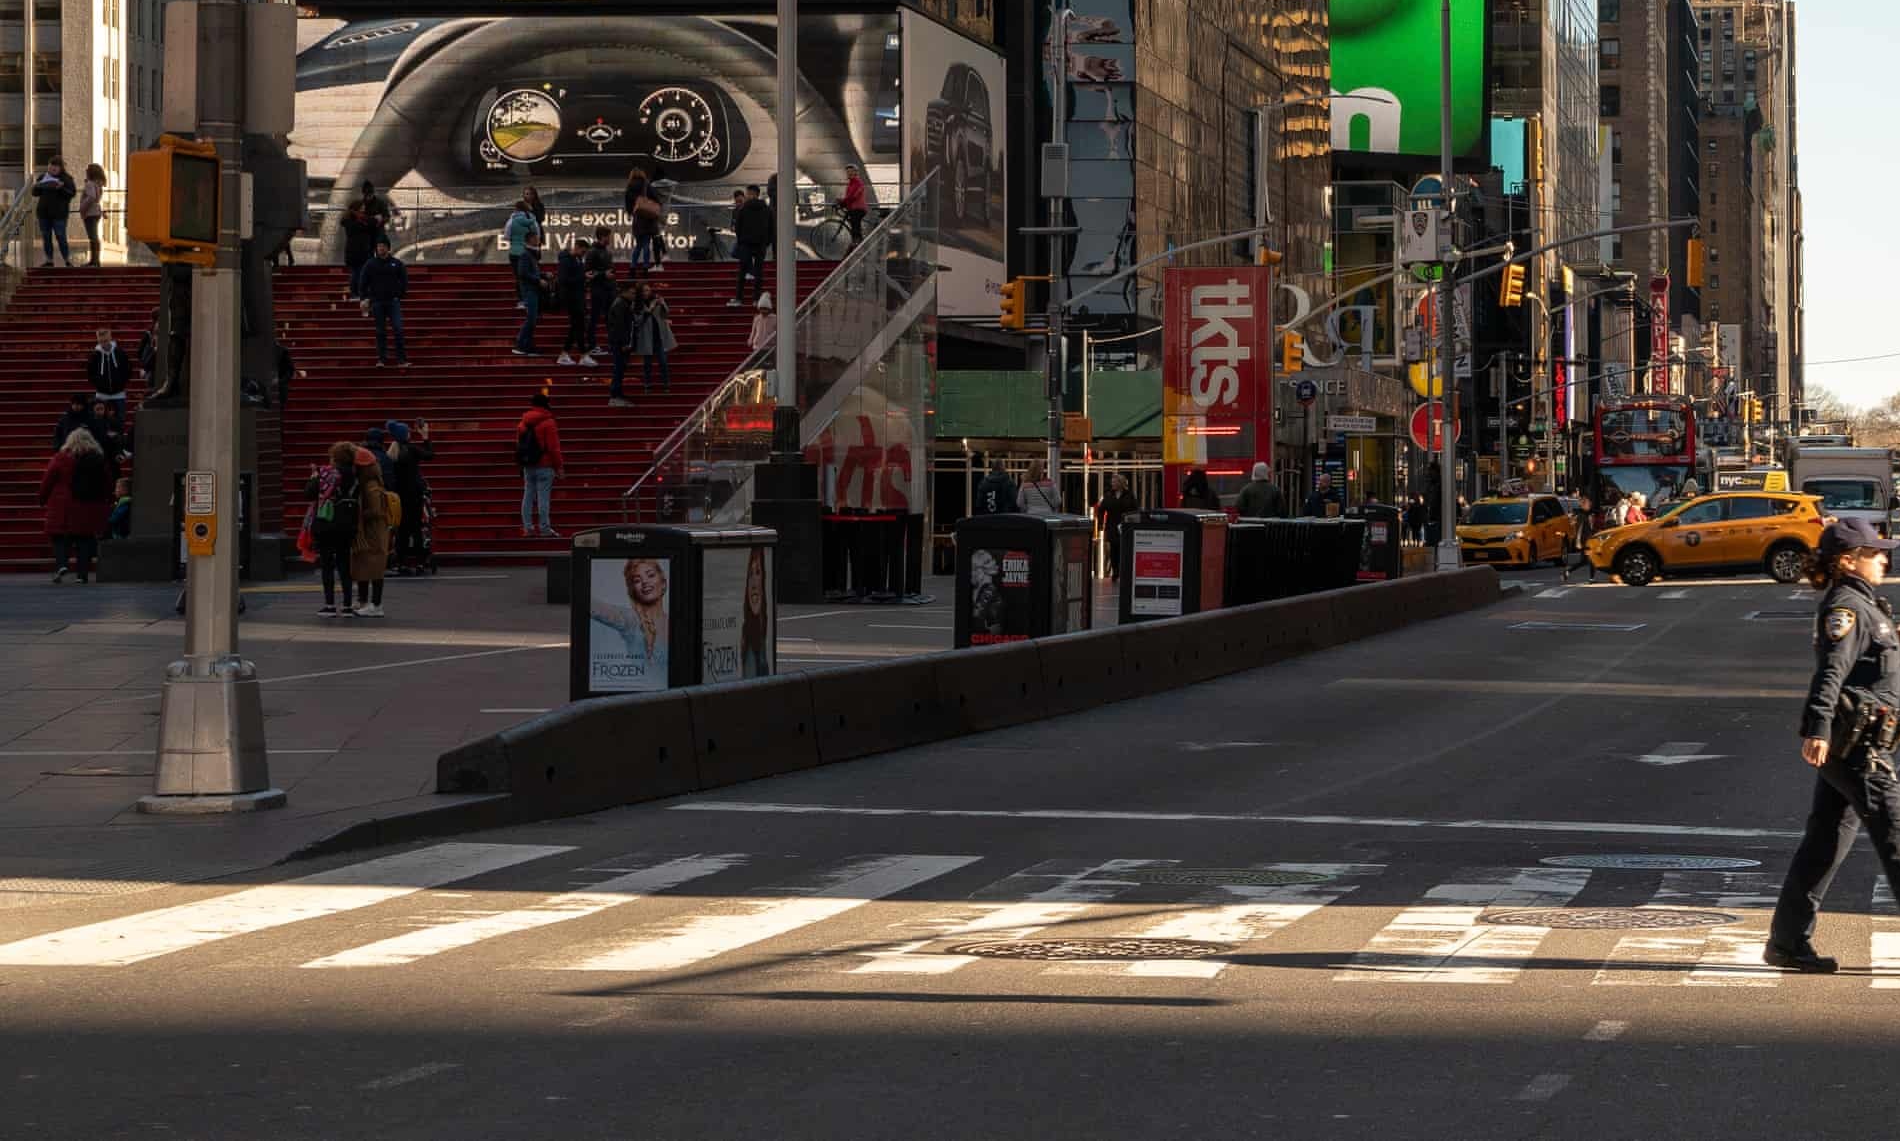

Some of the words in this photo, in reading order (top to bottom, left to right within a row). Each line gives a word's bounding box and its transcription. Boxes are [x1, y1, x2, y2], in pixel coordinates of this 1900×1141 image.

[613, 232, 697, 250] Mtor
[1190, 278, 1250, 407] tkts
[1001, 559, 1029, 572] ERIKA
[1000, 572, 1029, 583] JAYNE
[591, 661, 645, 679] FROZEN
